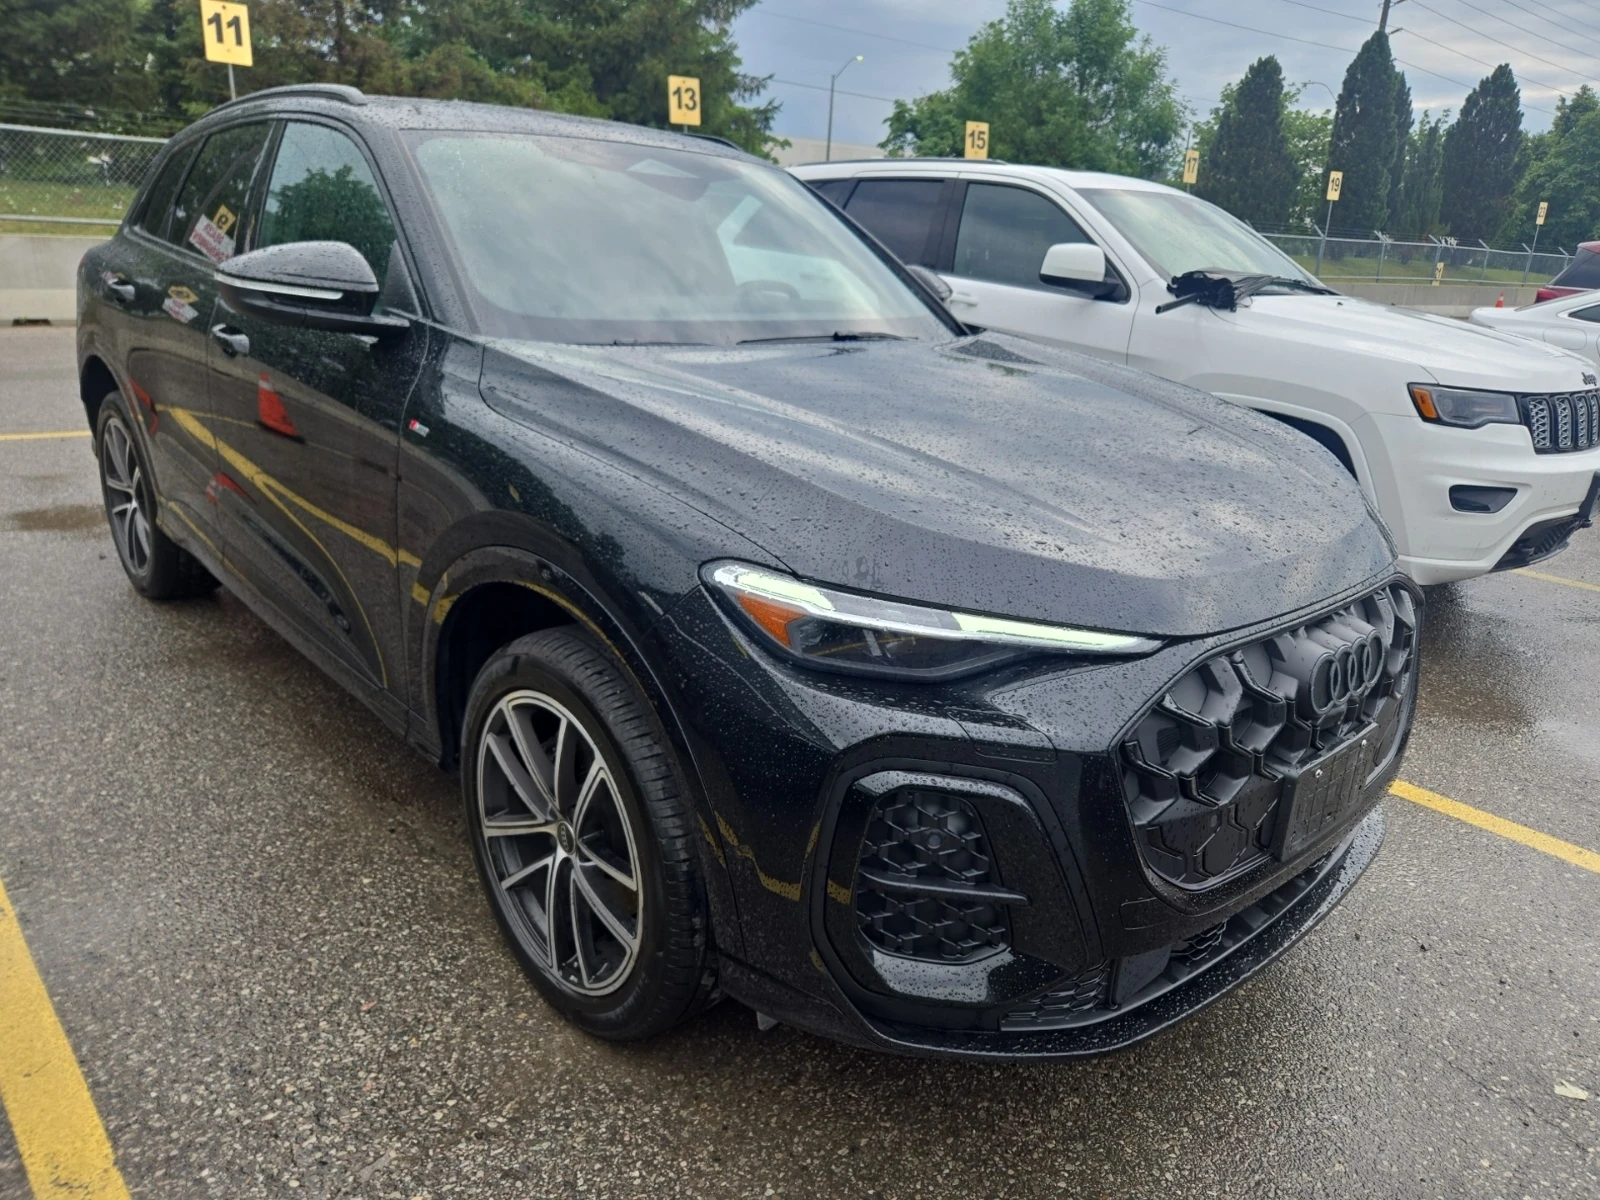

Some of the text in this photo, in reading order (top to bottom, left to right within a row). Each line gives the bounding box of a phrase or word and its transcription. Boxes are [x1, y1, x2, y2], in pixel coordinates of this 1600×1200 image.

[207, 12, 243, 47] 11
[673, 86, 697, 111] 13
[969, 130, 986, 150] 15
[1187, 156, 1197, 173] 17
[1331, 177, 1340, 191] 19
